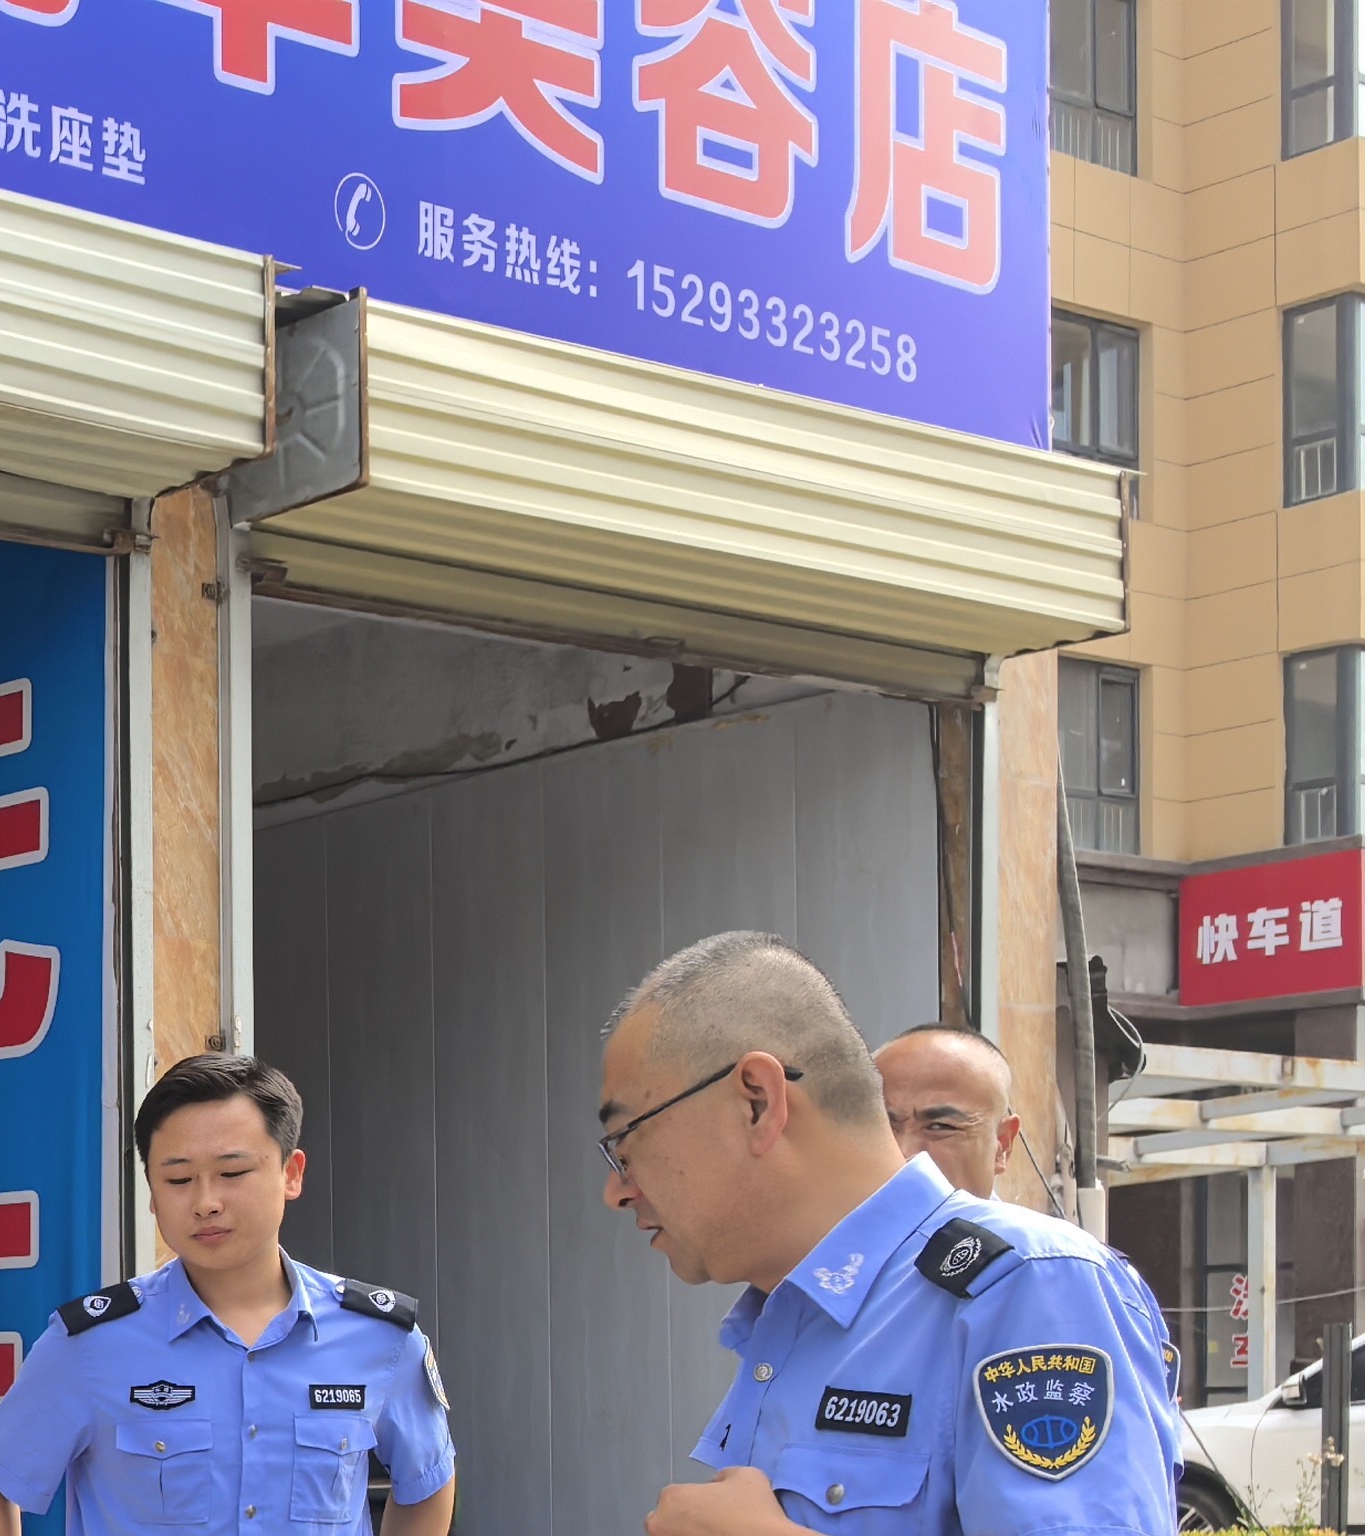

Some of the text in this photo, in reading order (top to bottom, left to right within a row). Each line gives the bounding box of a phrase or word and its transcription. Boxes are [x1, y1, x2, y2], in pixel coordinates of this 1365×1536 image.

[626, 260, 919, 384] 15293323258
[1196, 897, 1343, 965] 快车道
[983, 1354, 1097, 1383] 中华人民共和国
[314, 1389, 362, 1403] 6219065
[824, 1395, 902, 1429] 6219063
[991, 1378, 1095, 1415] 水政监察
